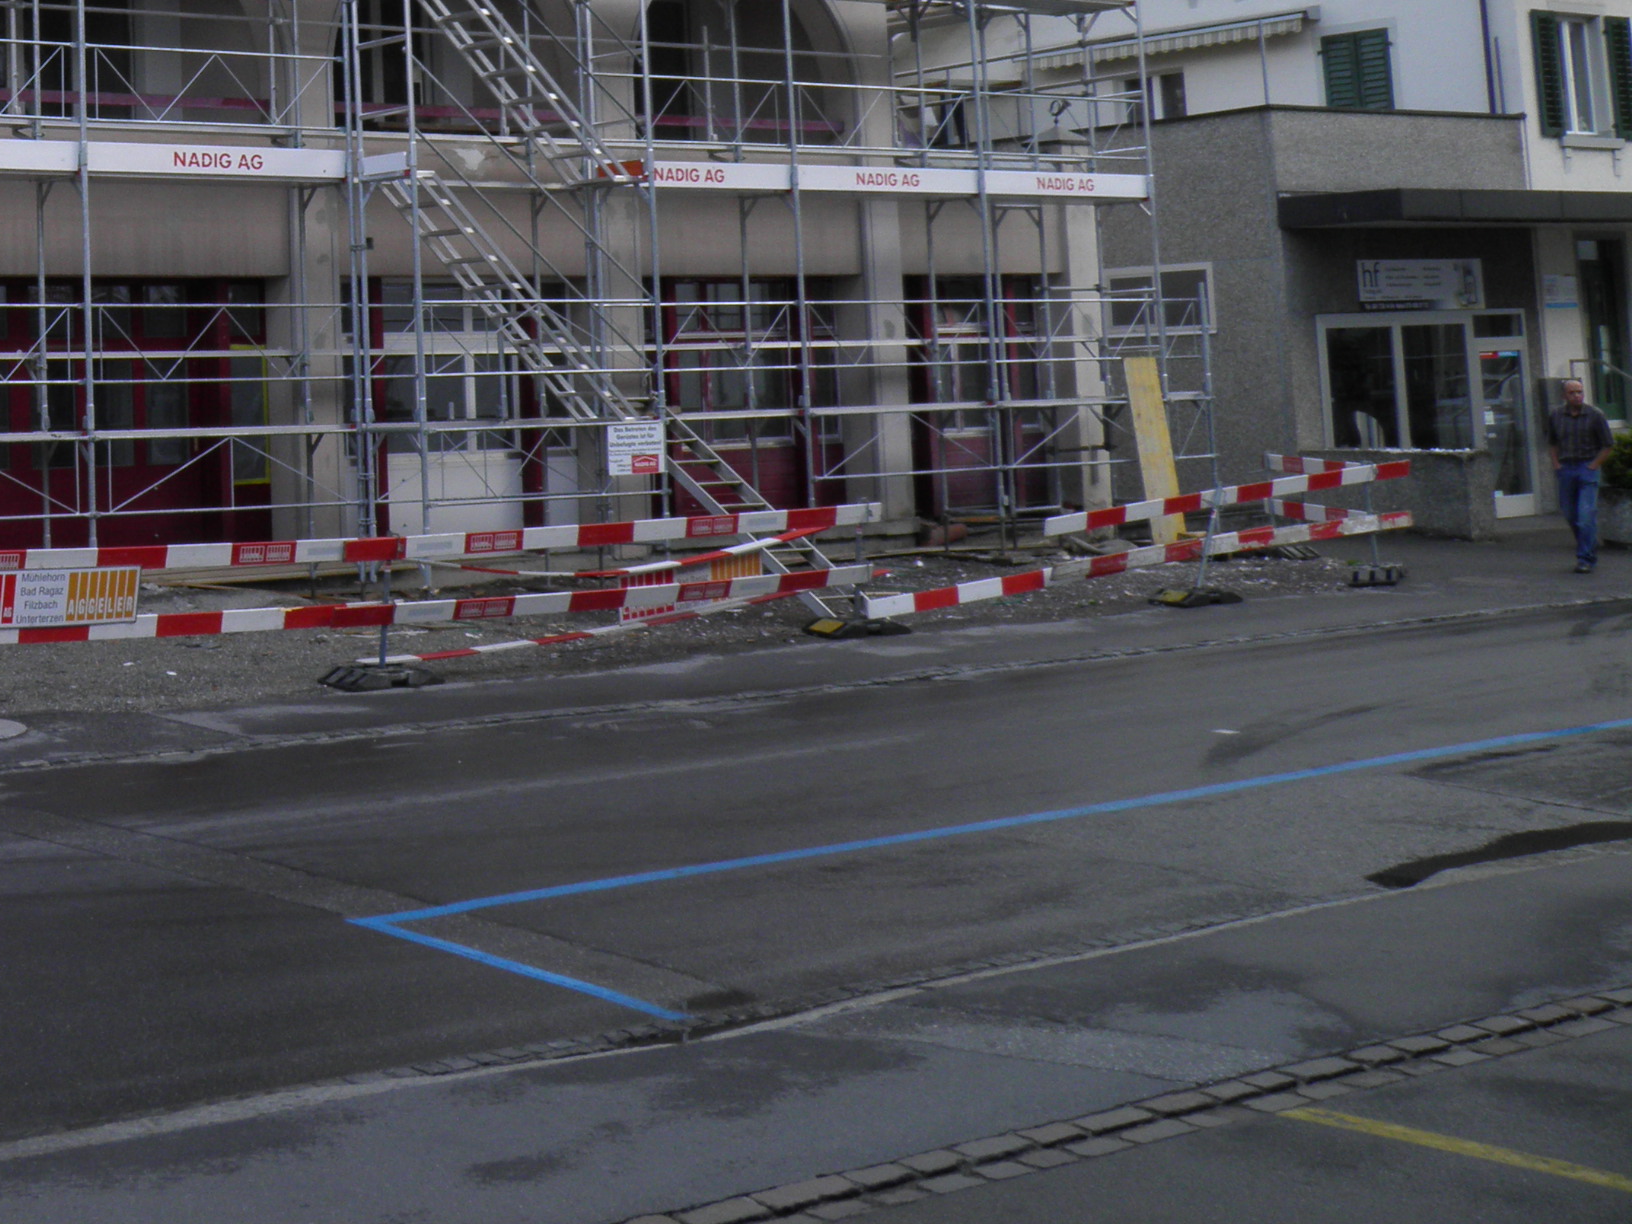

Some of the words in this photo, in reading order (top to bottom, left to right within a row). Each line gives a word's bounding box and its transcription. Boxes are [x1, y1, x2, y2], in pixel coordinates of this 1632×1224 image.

[173, 151, 232, 169] NADIG
[239, 154, 264, 171] AG
[653, 168, 700, 183] NADIG
[704, 169, 725, 183] AG
[856, 172, 898, 186] NADIG
[902, 174, 920, 187] AG
[1037, 177, 1075, 191] NADIG
[1078, 178, 1095, 192] AG
[21, 572, 66, 583] Mühlehorn
[20, 586, 37, 596] Bad
[38, 586, 64, 598] Ragaz
[23, 599, 59, 610] Filzbach
[66, 596, 134, 616] AGGELER
[15, 613, 64, 625] Unterterzen
